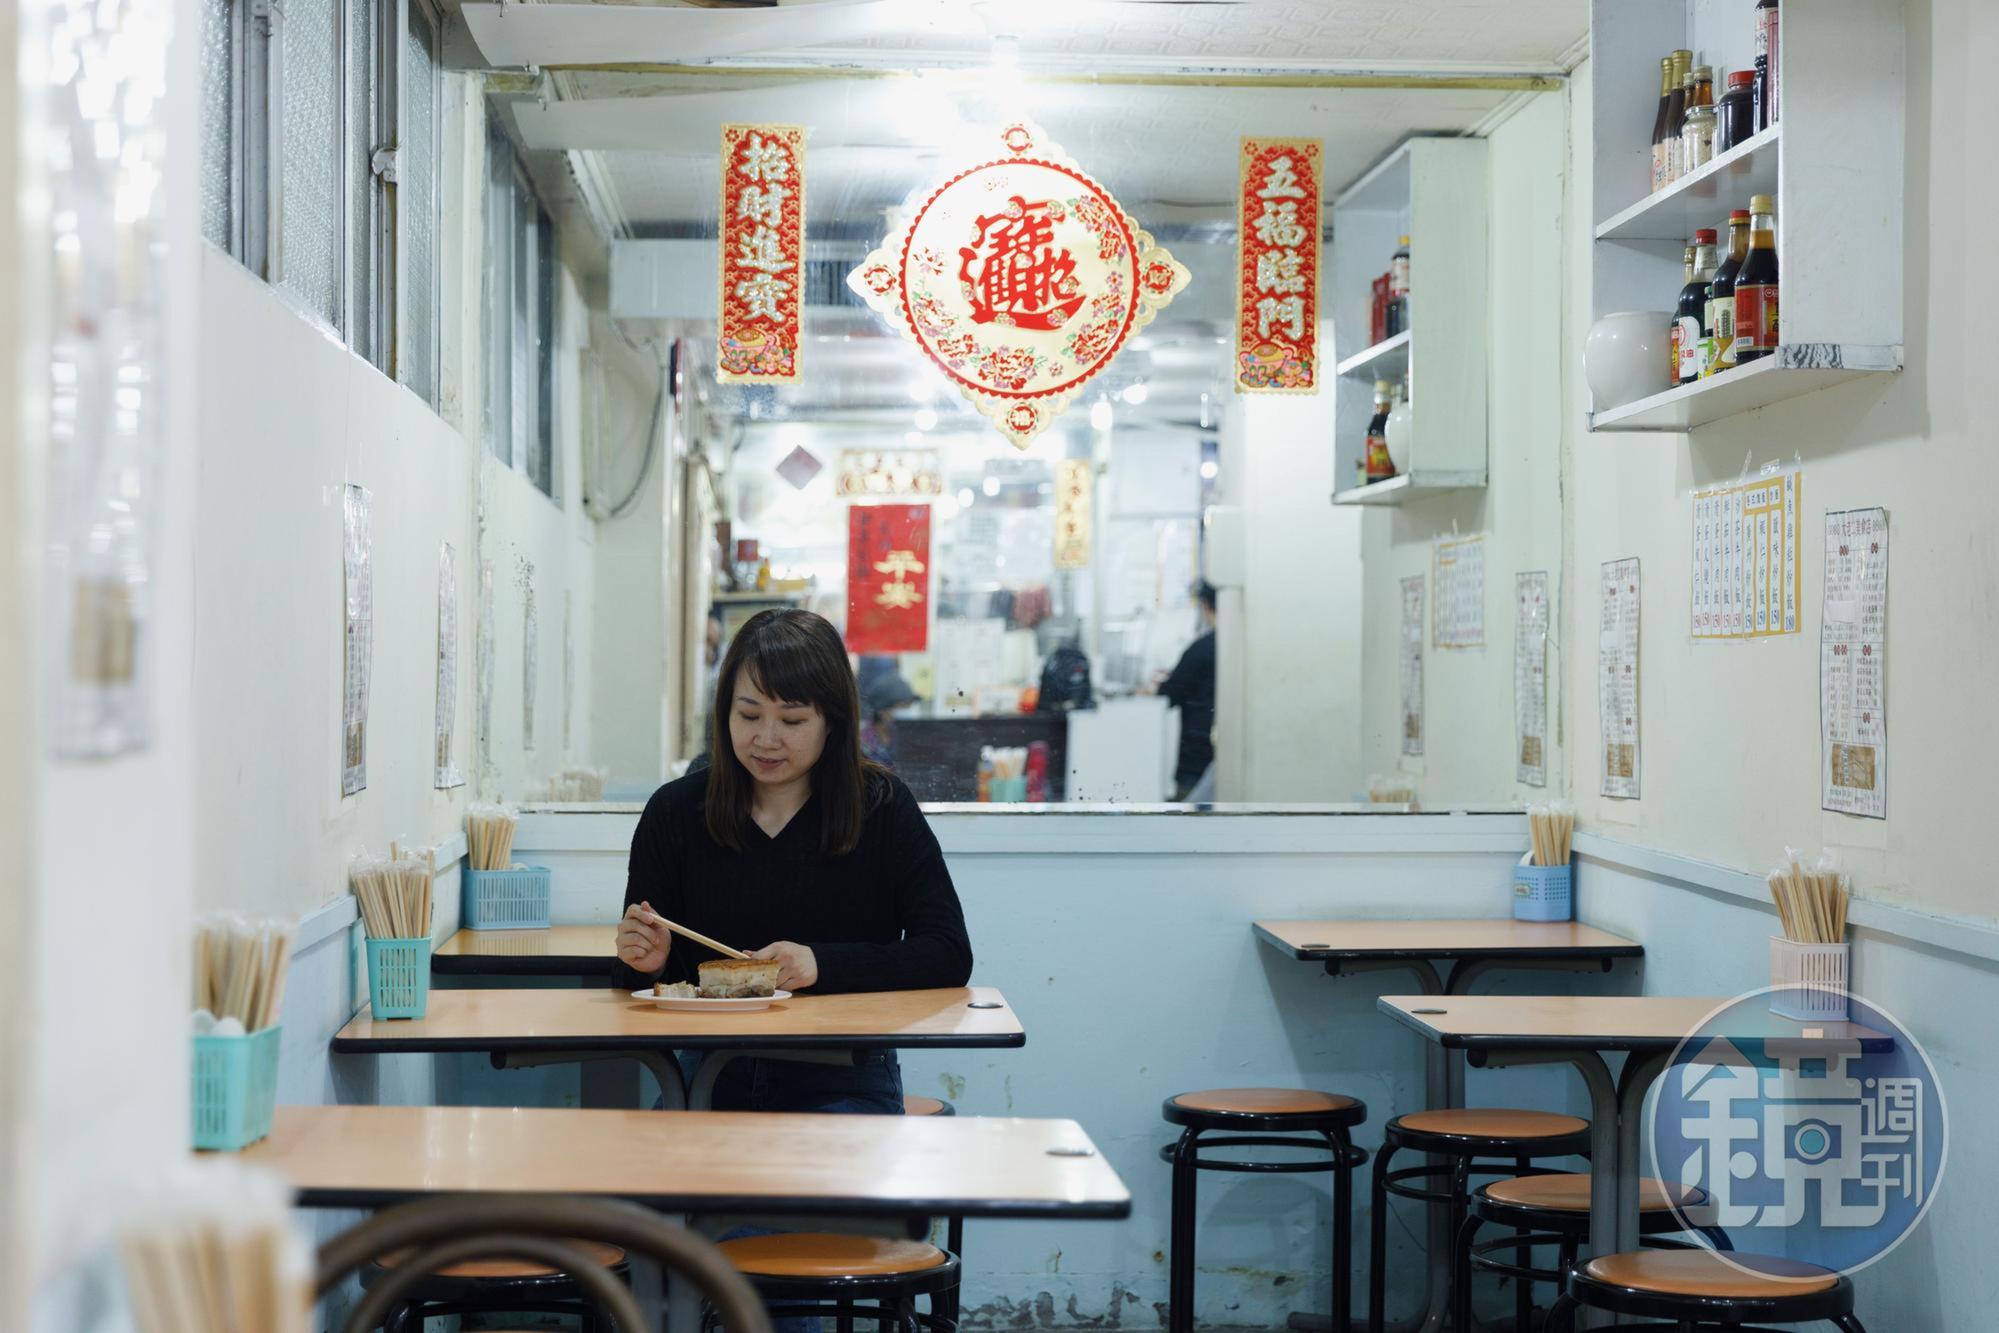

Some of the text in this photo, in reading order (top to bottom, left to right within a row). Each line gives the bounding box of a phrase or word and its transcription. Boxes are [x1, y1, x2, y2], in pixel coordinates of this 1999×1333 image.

[735, 133, 796, 322] 招財進寶
[1252, 155, 1307, 341] 五福臨門
